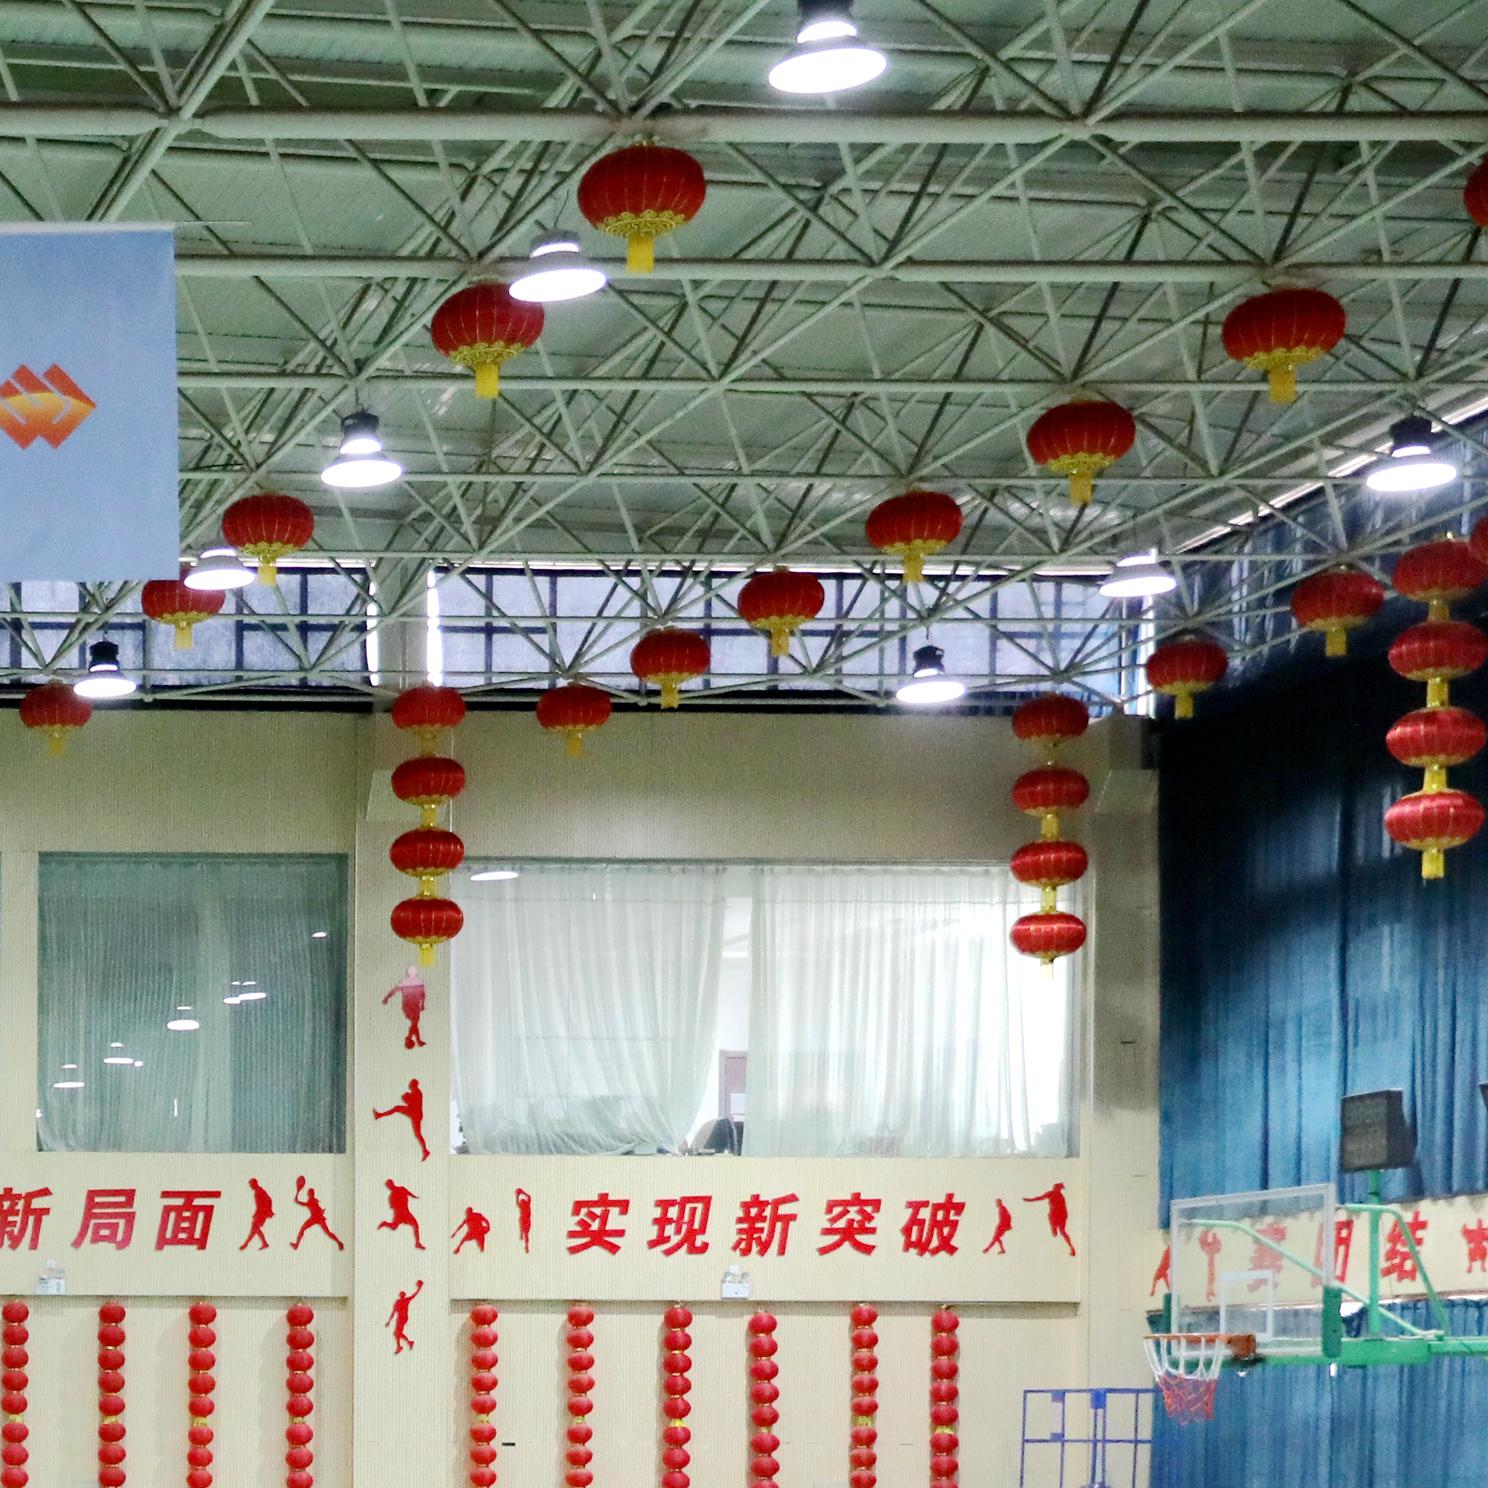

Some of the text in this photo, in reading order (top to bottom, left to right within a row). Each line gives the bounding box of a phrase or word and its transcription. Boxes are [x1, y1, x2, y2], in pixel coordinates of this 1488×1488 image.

[566, 1191, 966, 1258] 实现新突破
